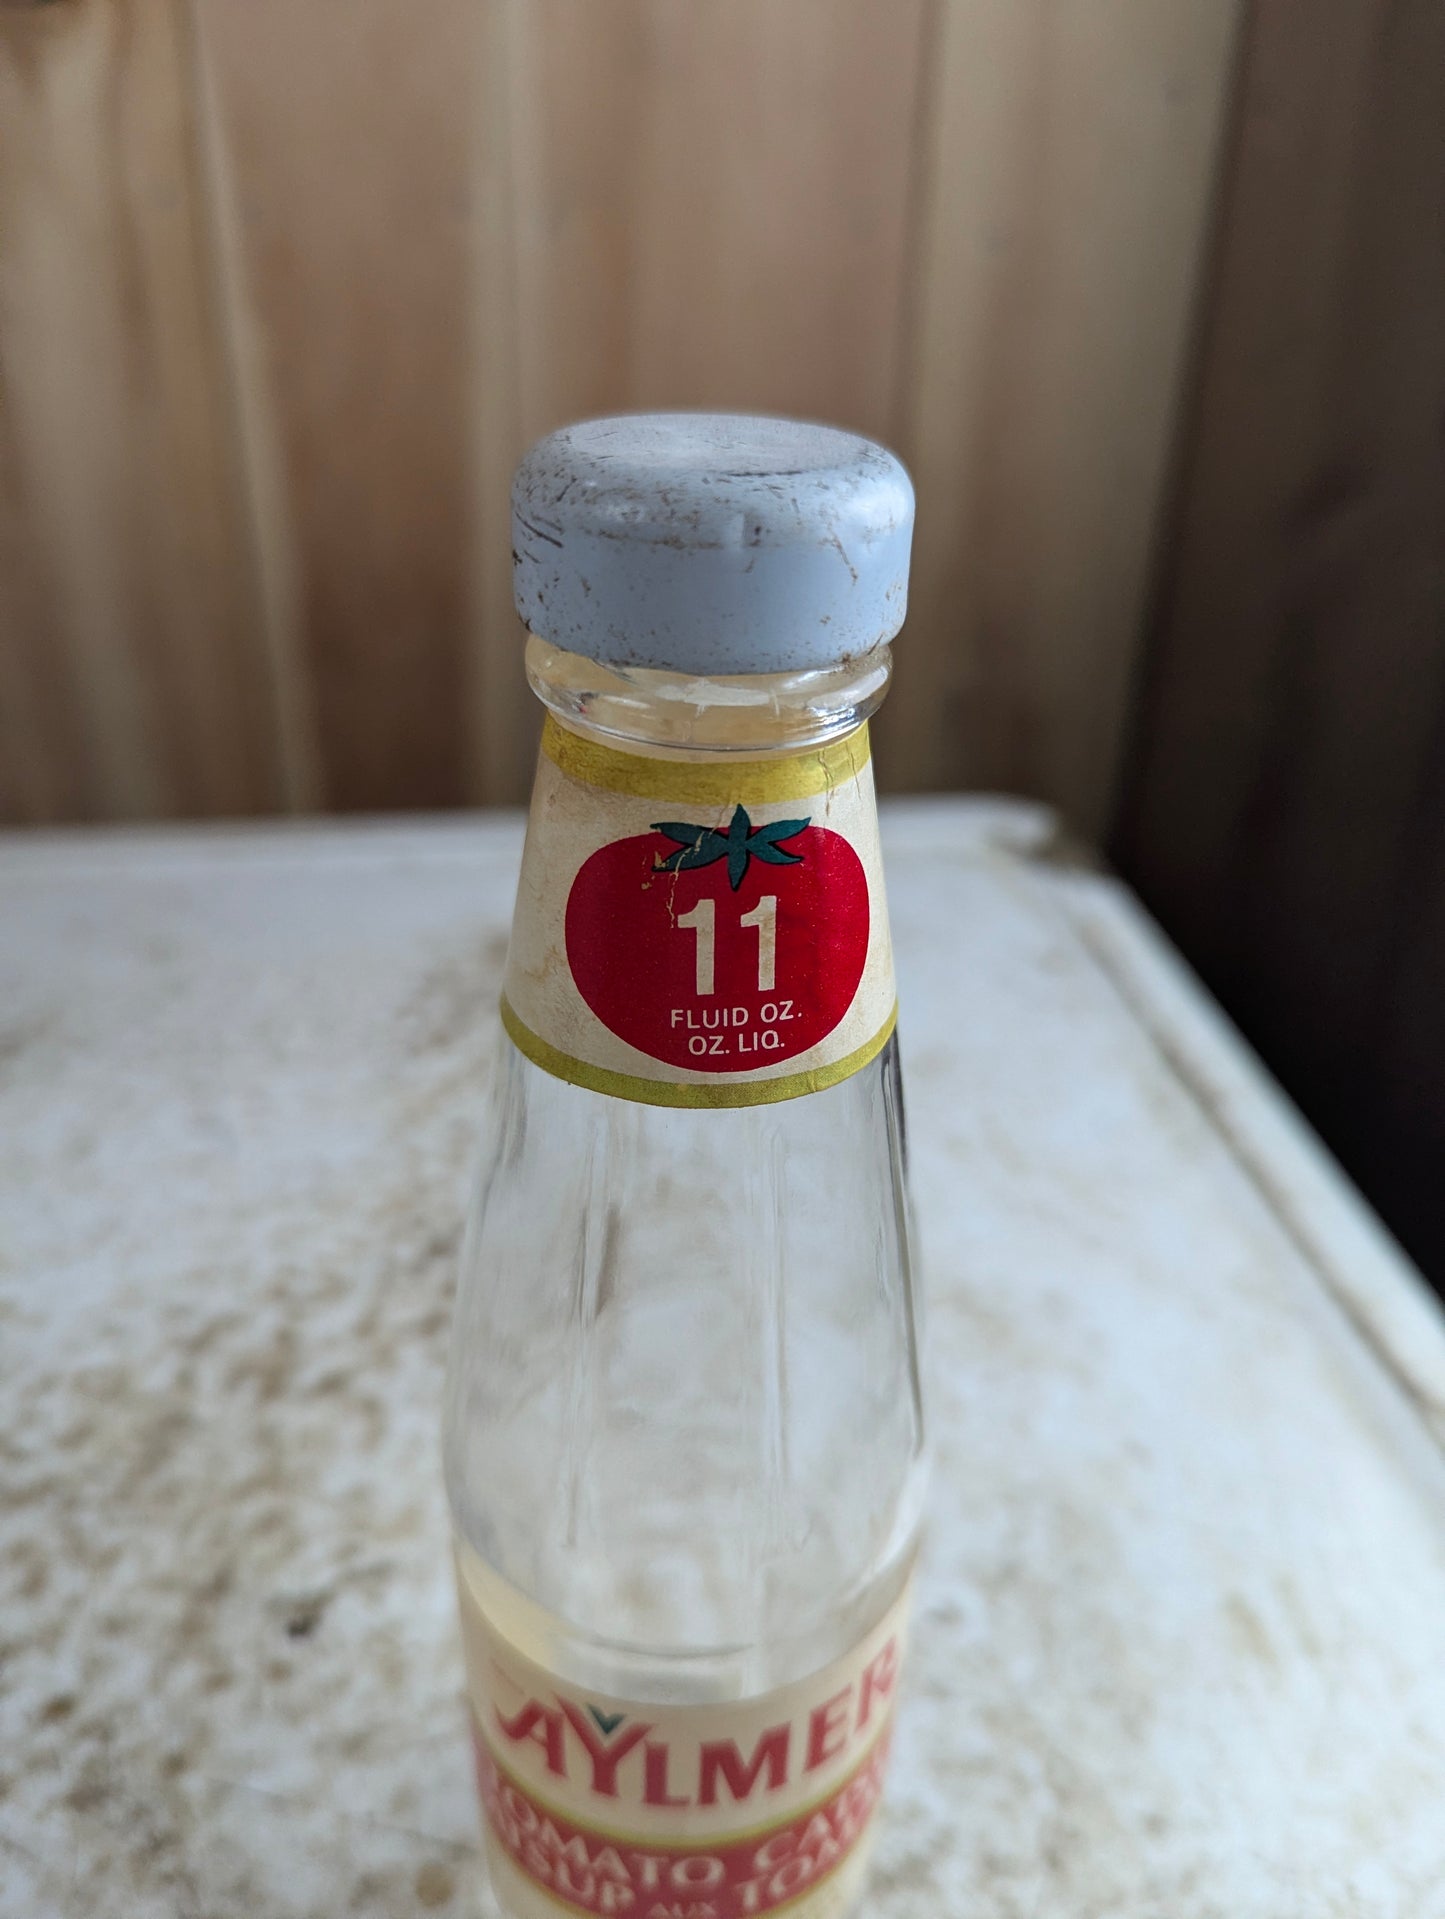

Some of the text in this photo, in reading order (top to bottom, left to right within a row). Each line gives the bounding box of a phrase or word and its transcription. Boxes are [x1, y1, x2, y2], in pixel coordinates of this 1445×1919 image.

[677, 895, 776, 996] 11
[671, 1000, 802, 1029] FLUID OZ.
[688, 1029, 785, 1055] OZ. LIQ.
